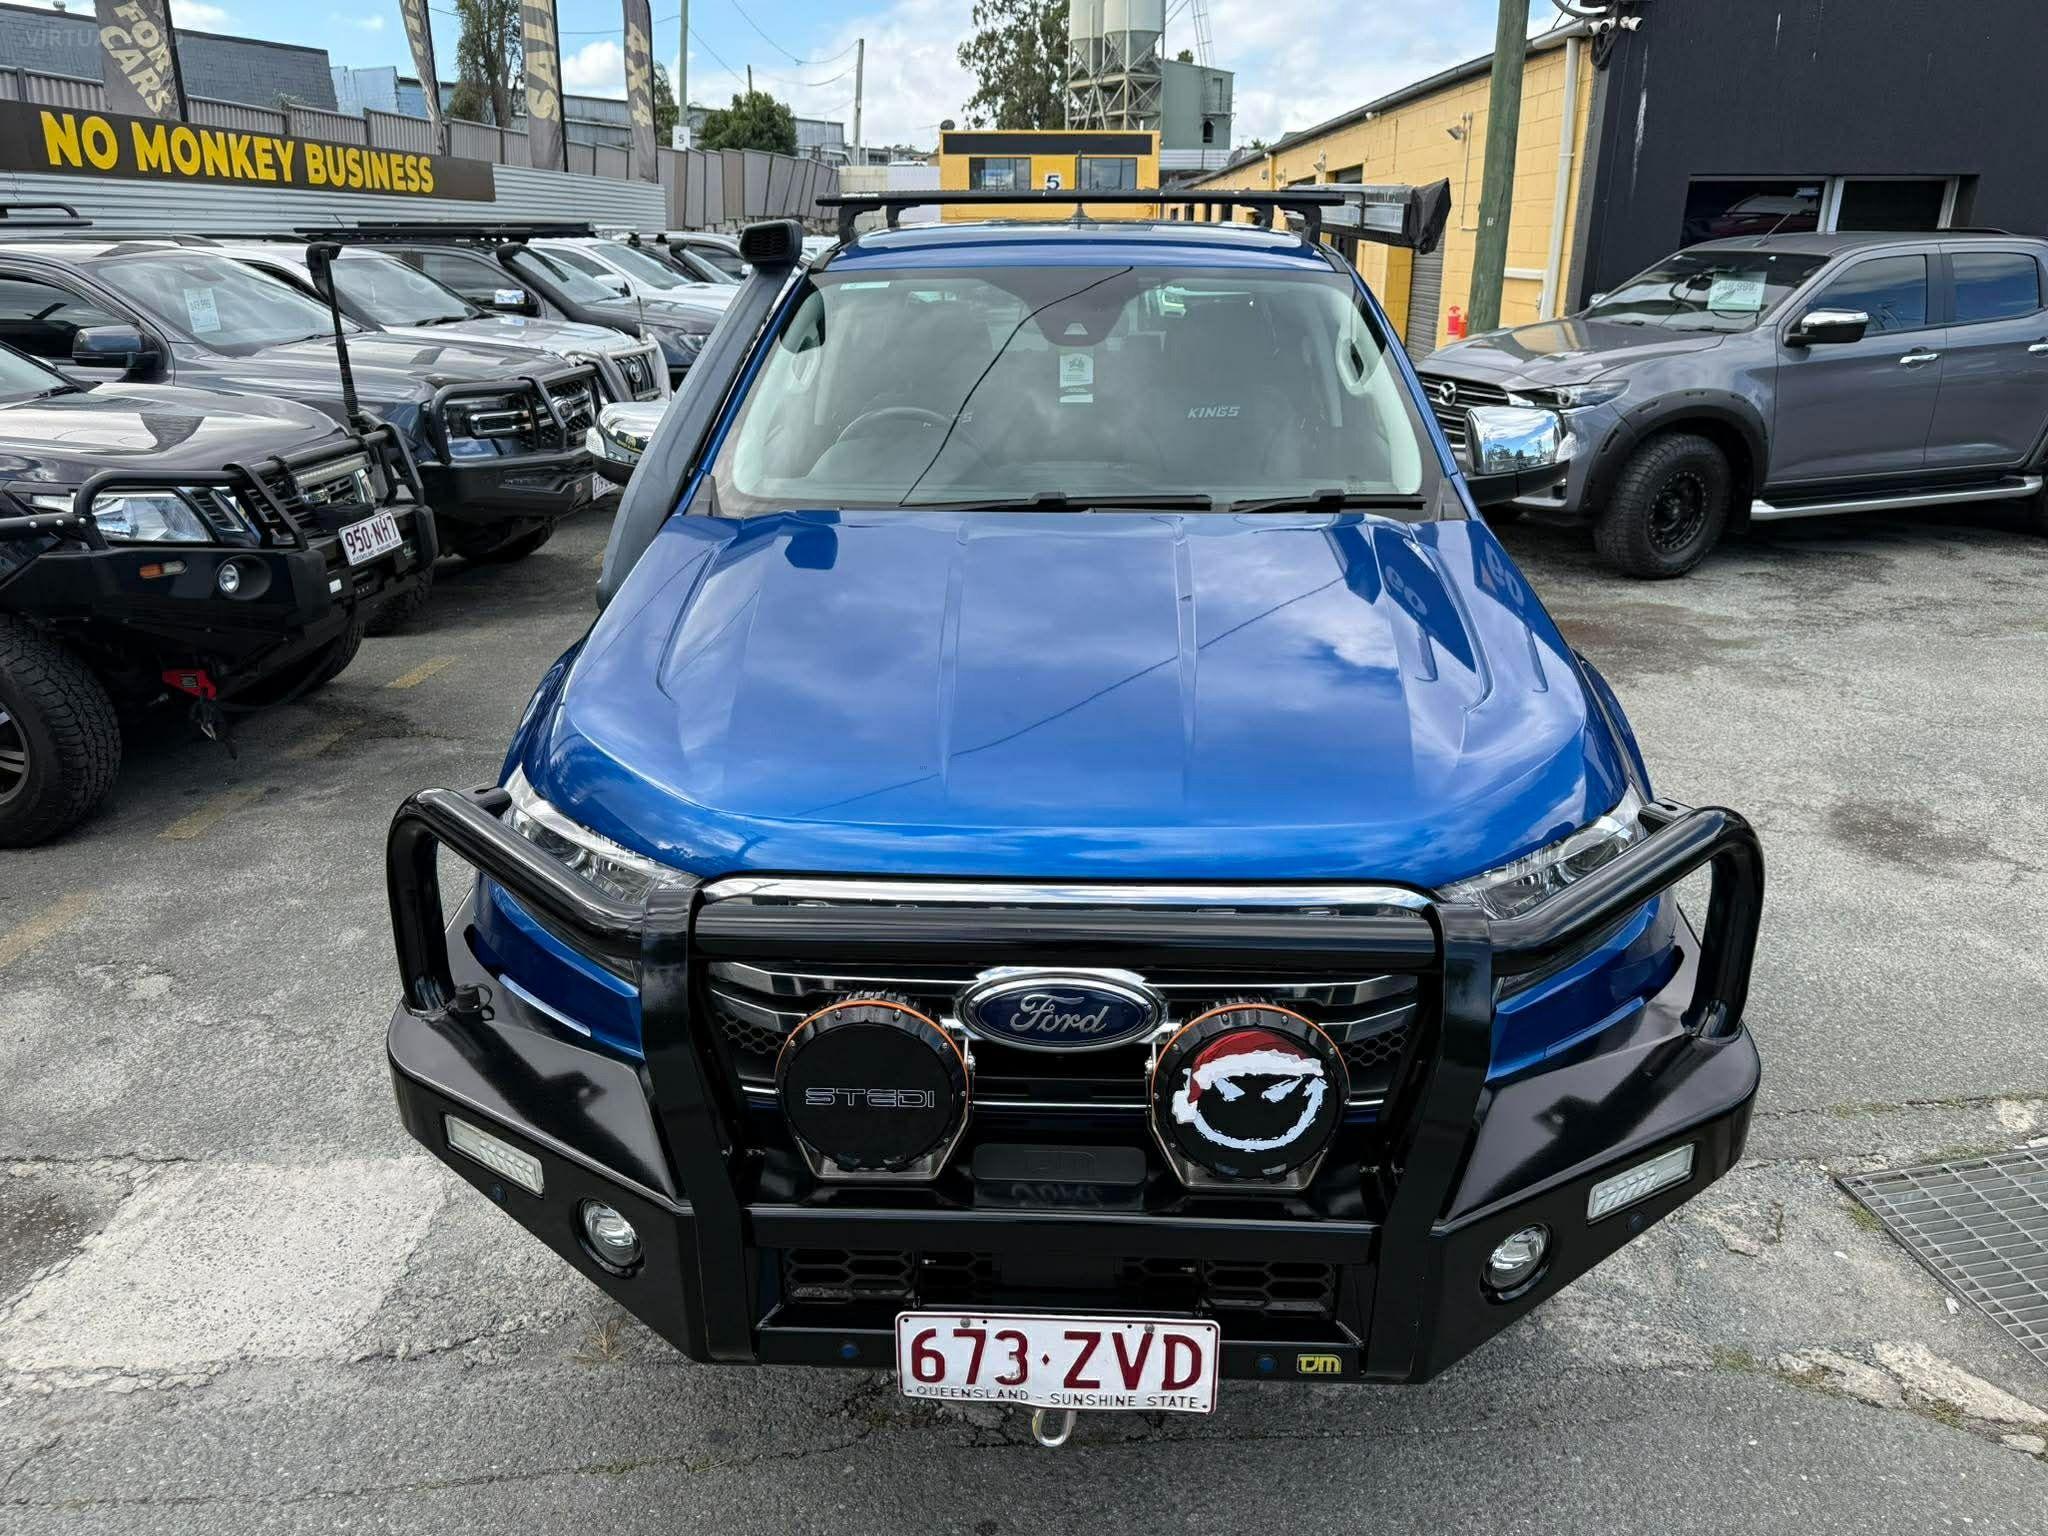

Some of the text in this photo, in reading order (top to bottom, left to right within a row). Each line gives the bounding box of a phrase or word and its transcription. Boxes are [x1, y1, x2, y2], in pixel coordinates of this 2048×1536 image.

[113, 2, 172, 74] FOR
[100, 26, 172, 113] CARS
[522, 0, 560, 122] SAL
[40, 110, 434, 193] NO MONKEY BUSINESS
[1047, 175, 1060, 190] 5
[1187, 406, 1240, 418] KINGS
[1010, 994, 1110, 1032] Ford
[805, 1087, 935, 1108] STEDI
[917, 1386, 1030, 1401] QUEENSLAND
[1051, 1393, 1137, 1407] SUNSHINE
[1146, 1396, 1199, 1408] STATE
